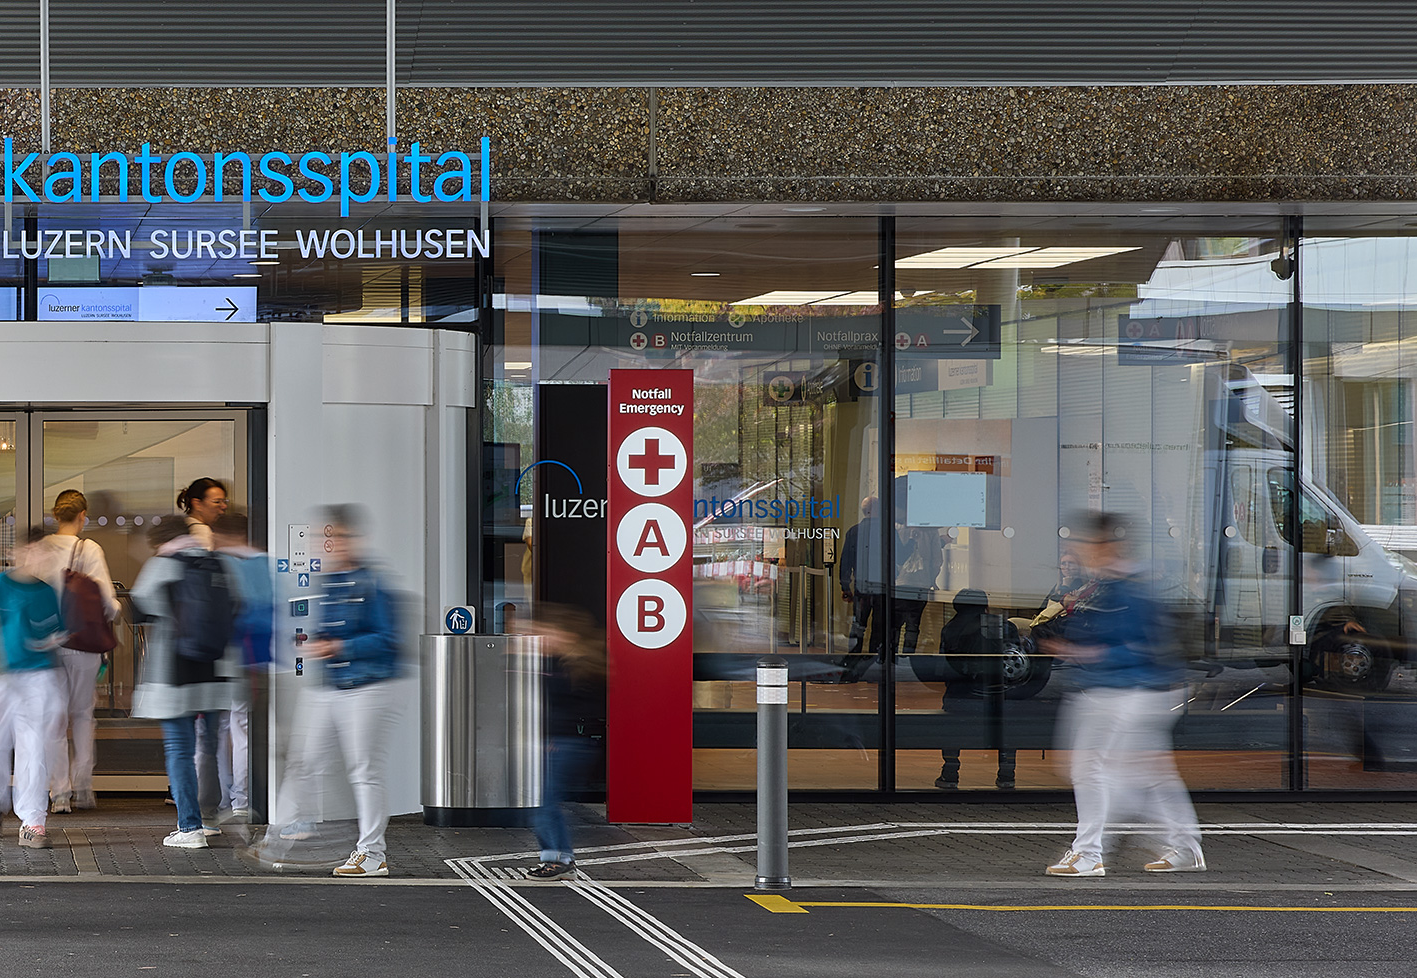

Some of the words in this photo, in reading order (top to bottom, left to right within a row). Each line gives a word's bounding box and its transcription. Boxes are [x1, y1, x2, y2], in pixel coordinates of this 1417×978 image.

[3, 137, 490, 217] kantonsspital
[3, 229, 131, 260] LUZERN
[149, 229, 279, 260] SURSEE
[296, 229, 491, 260] WOLHUSEN
[48, 304, 80, 313] luzerner
[81, 304, 132, 313] kantonsspital
[752, 312, 804, 325] Apotheke
[655, 335, 665, 347] B
[670, 331, 753, 342] Notfallzentrum
[817, 331, 879, 344] Notfallprax
[916, 335, 928, 347] A
[632, 388, 672, 400] Notfall
[619, 403, 685, 416] Emergency
[545, 493, 608, 518] luzer
[694, 494, 840, 524] ntonsspital
[632, 519, 671, 557] A
[715, 528, 763, 539] SURSEE
[770, 528, 840, 539] WOLHUSEN
[637, 595, 666, 633] B
